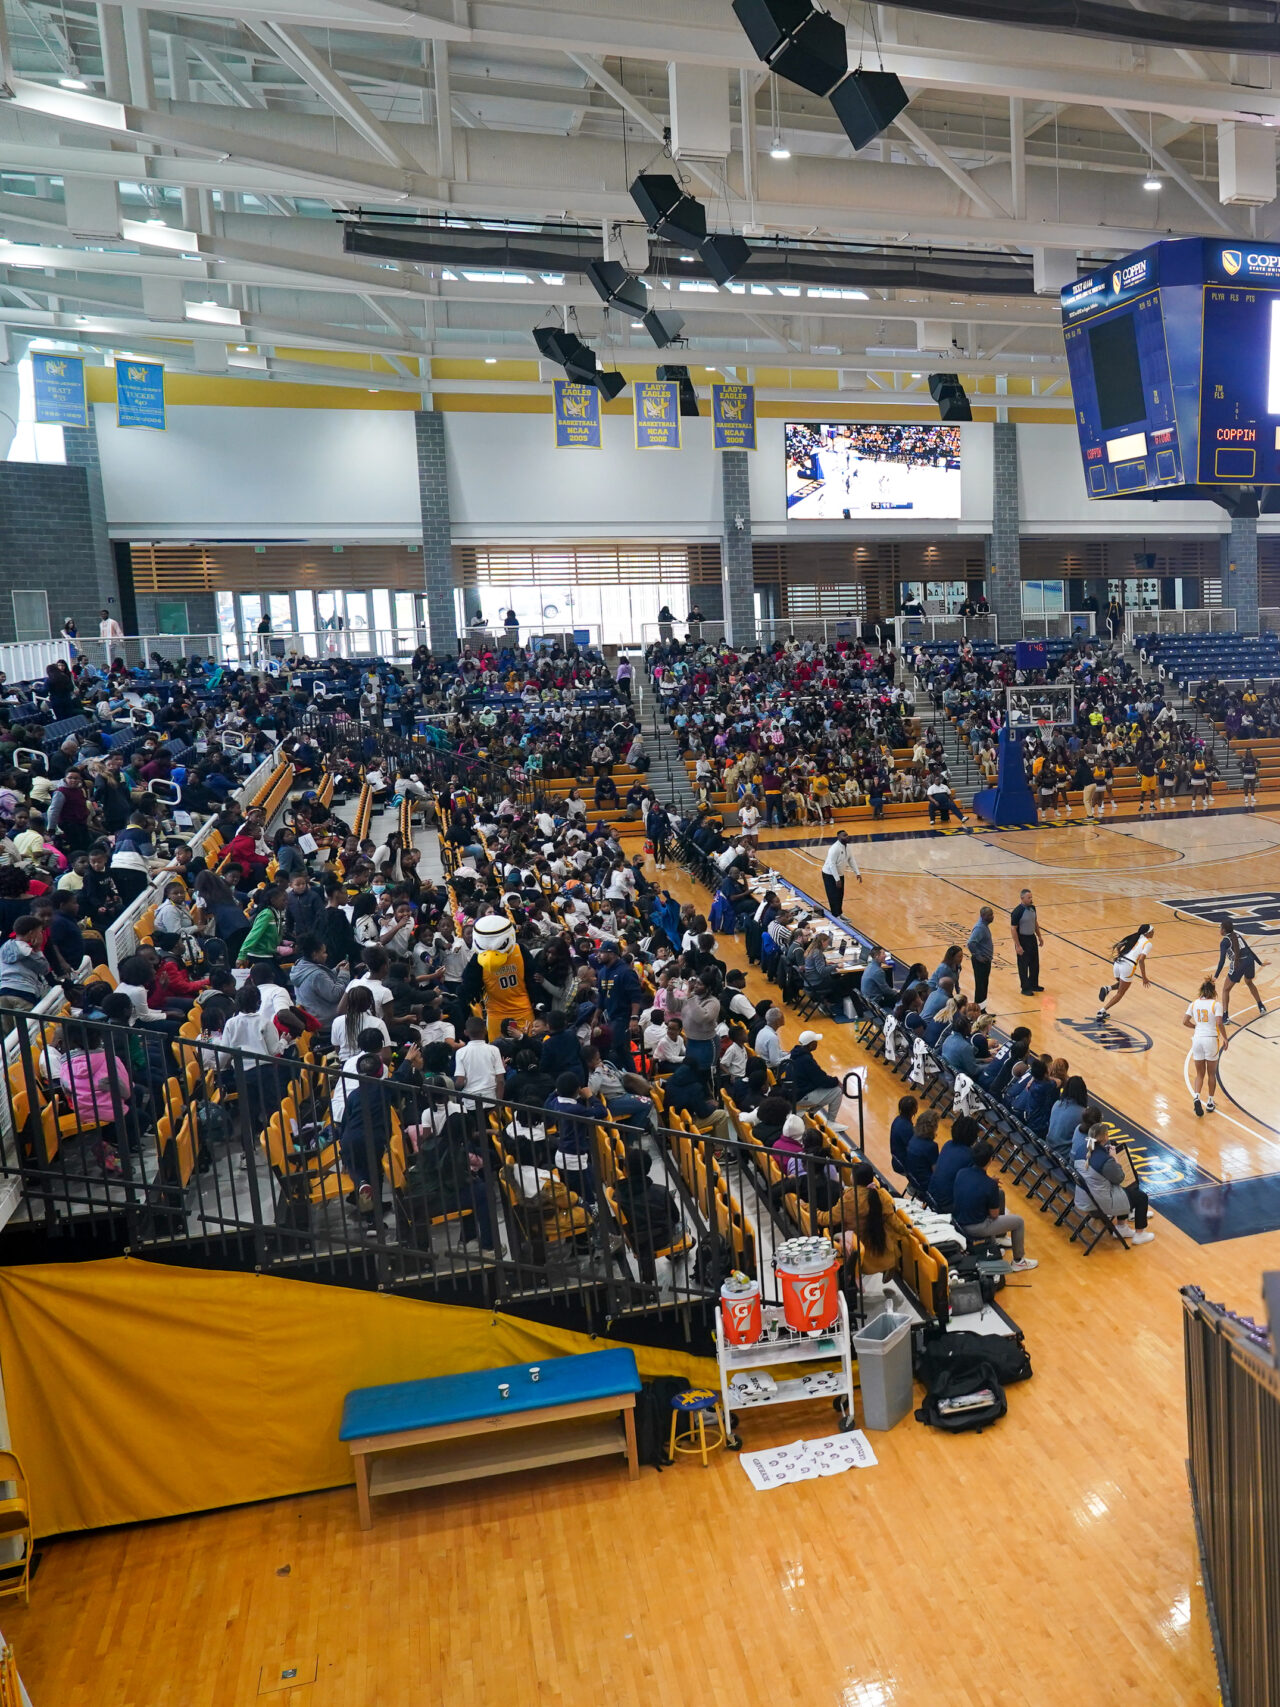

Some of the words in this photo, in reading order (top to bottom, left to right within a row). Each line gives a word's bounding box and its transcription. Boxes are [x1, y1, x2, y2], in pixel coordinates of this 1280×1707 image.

[1122, 259, 1147, 280] COPPIN
[1211, 293, 1225, 301] PLYR
[1230, 293, 1239, 301] FLS
[1214, 391, 1224, 399] FLS
[1217, 428, 1256, 441] COPPIN
[499, 974, 518, 990] 00
[804, 1283, 821, 1300] G
[734, 1303, 749, 1317] G
